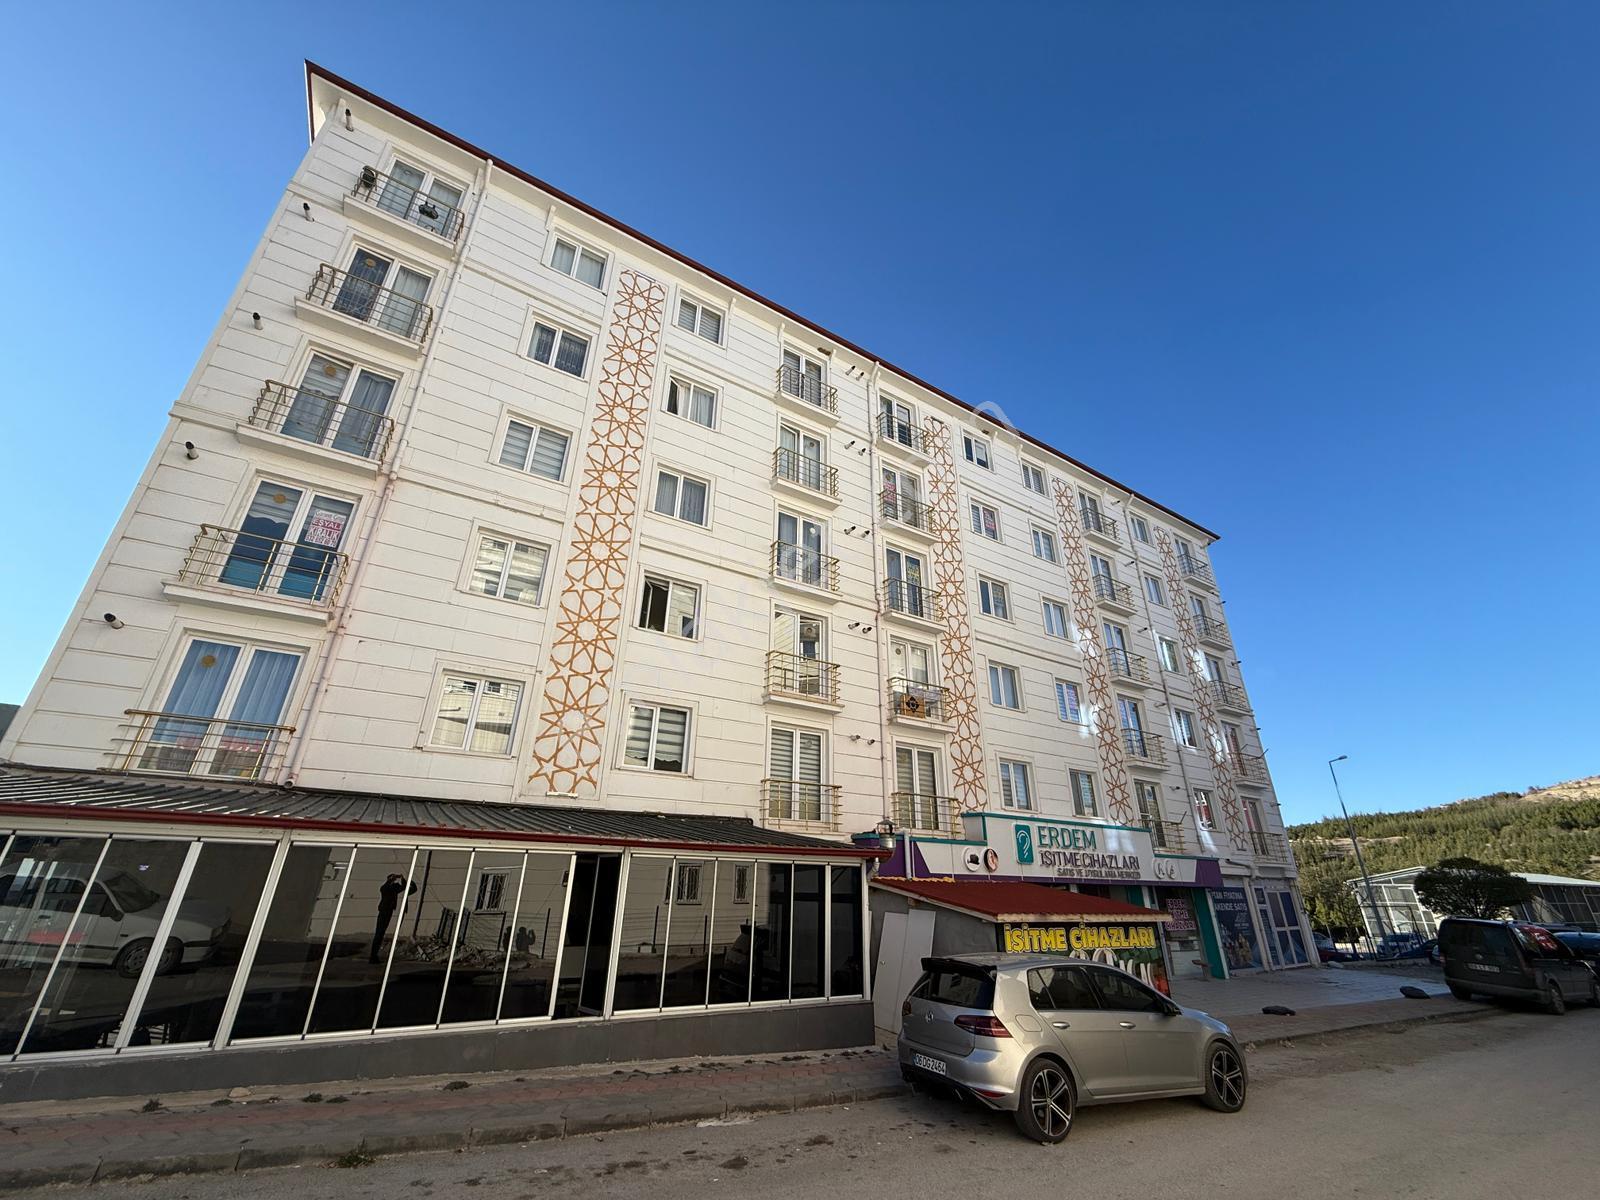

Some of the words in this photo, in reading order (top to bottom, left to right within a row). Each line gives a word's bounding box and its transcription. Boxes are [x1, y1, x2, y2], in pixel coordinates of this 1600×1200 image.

[1038, 826, 1096, 849] ERDEM
[1003, 923, 1067, 952] İŞİTME
[1069, 923, 1156, 950] CİHAZLARI
